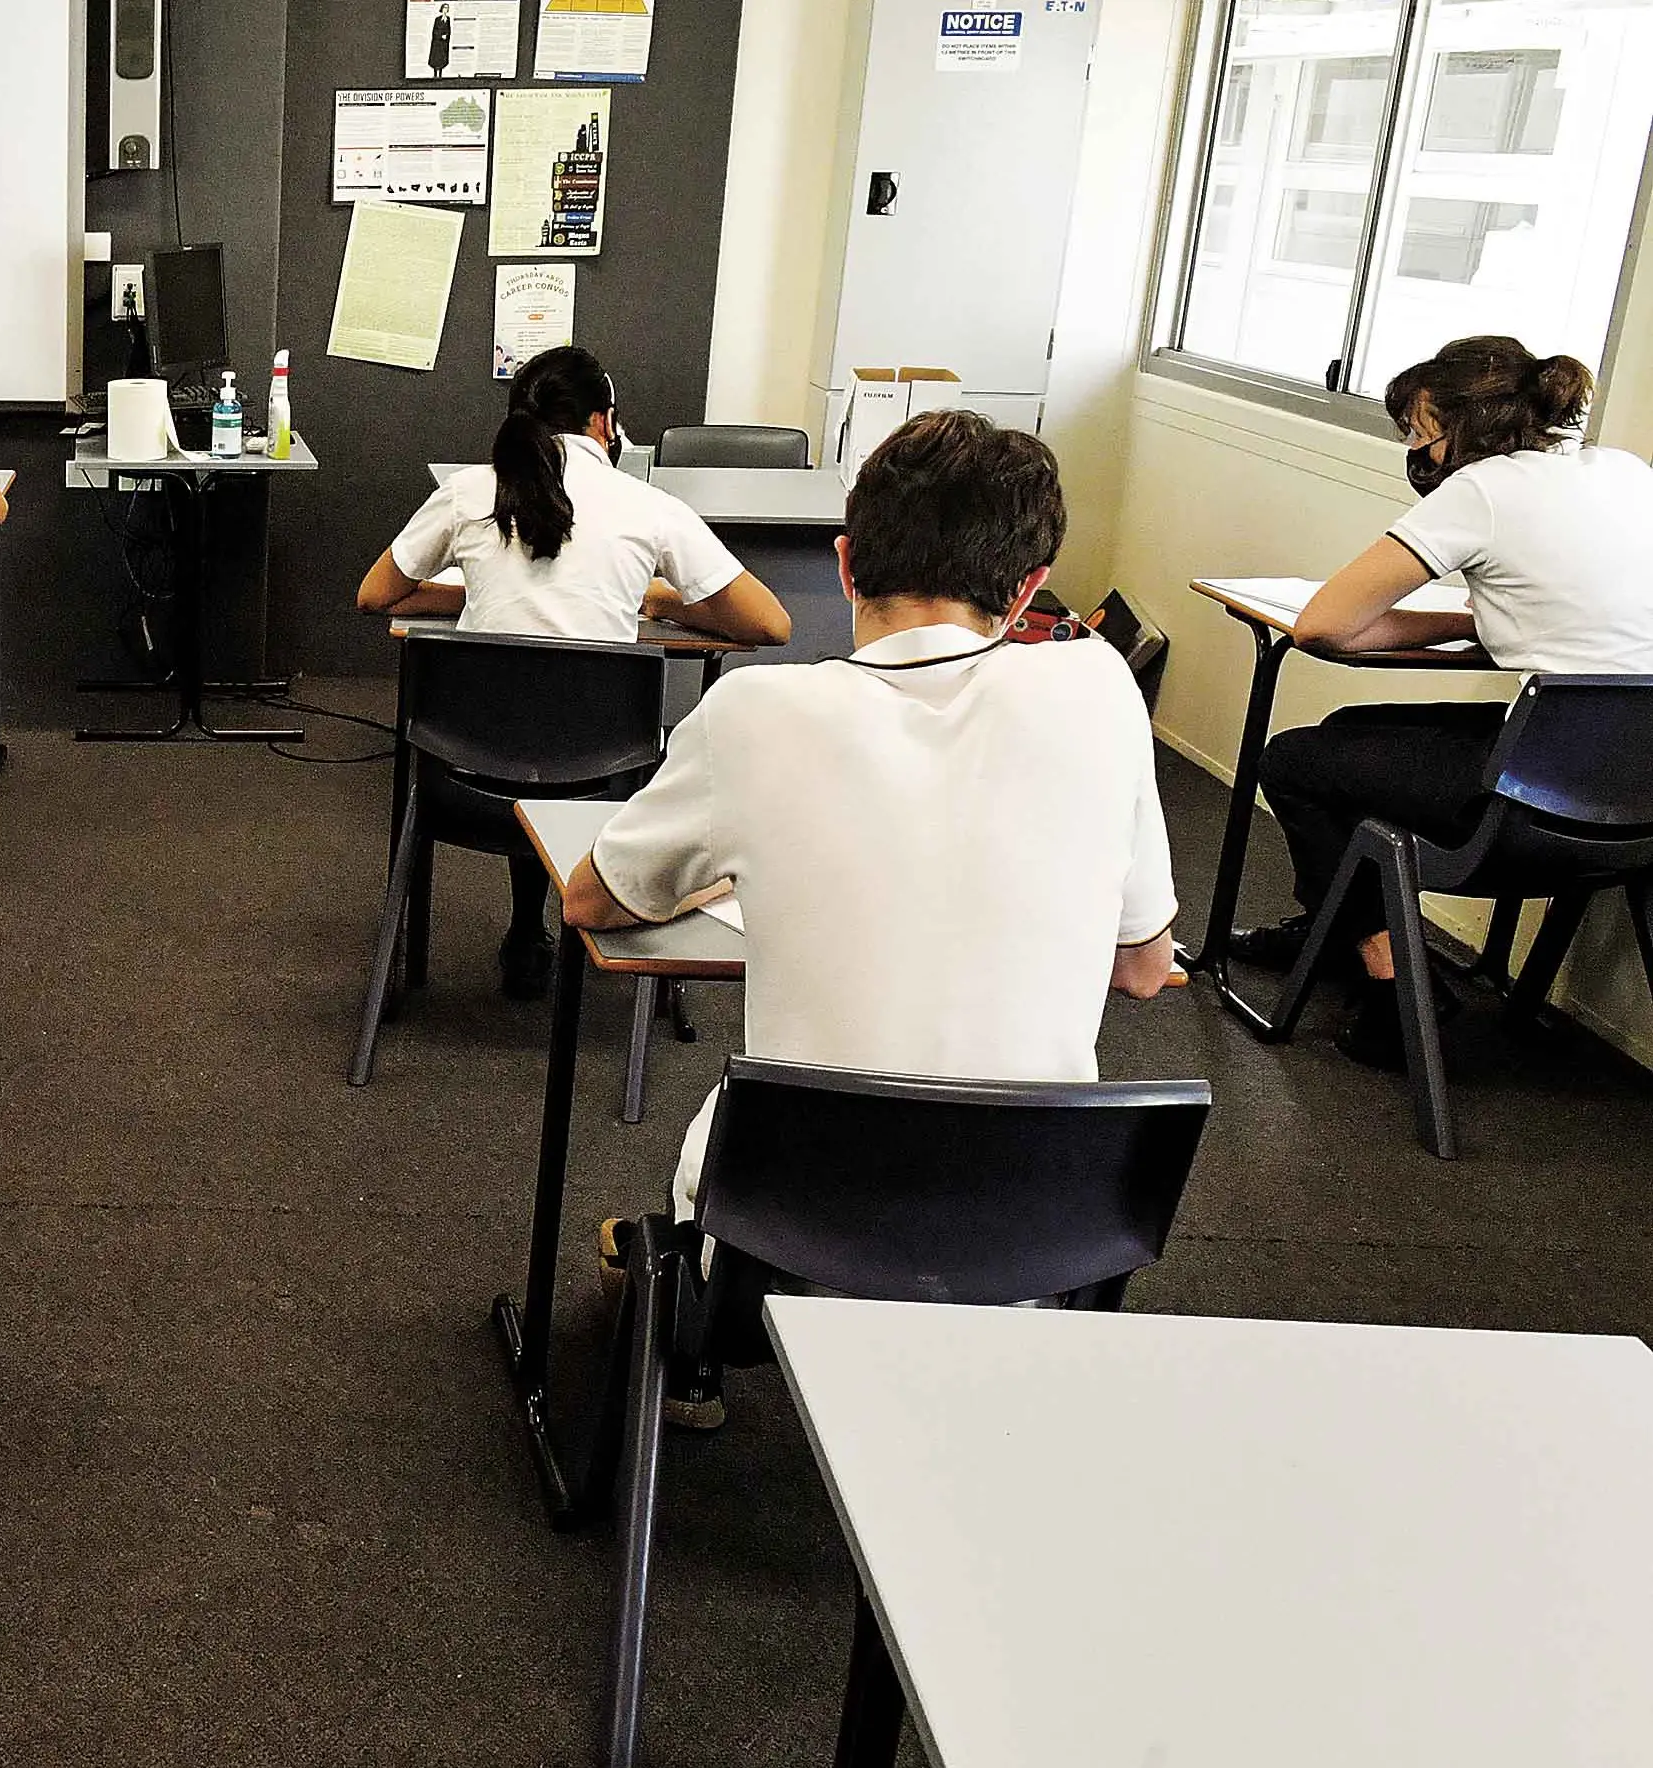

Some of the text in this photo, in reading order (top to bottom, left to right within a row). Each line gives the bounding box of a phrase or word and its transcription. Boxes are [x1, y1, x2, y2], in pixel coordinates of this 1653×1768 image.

[946, 14, 1015, 30] NOTICE
[353, 92, 383, 102] DIVISION
[385, 92, 393, 101] OF
[395, 92, 425, 101] POWERS
[500, 283, 570, 300] CAREER CONVOS
